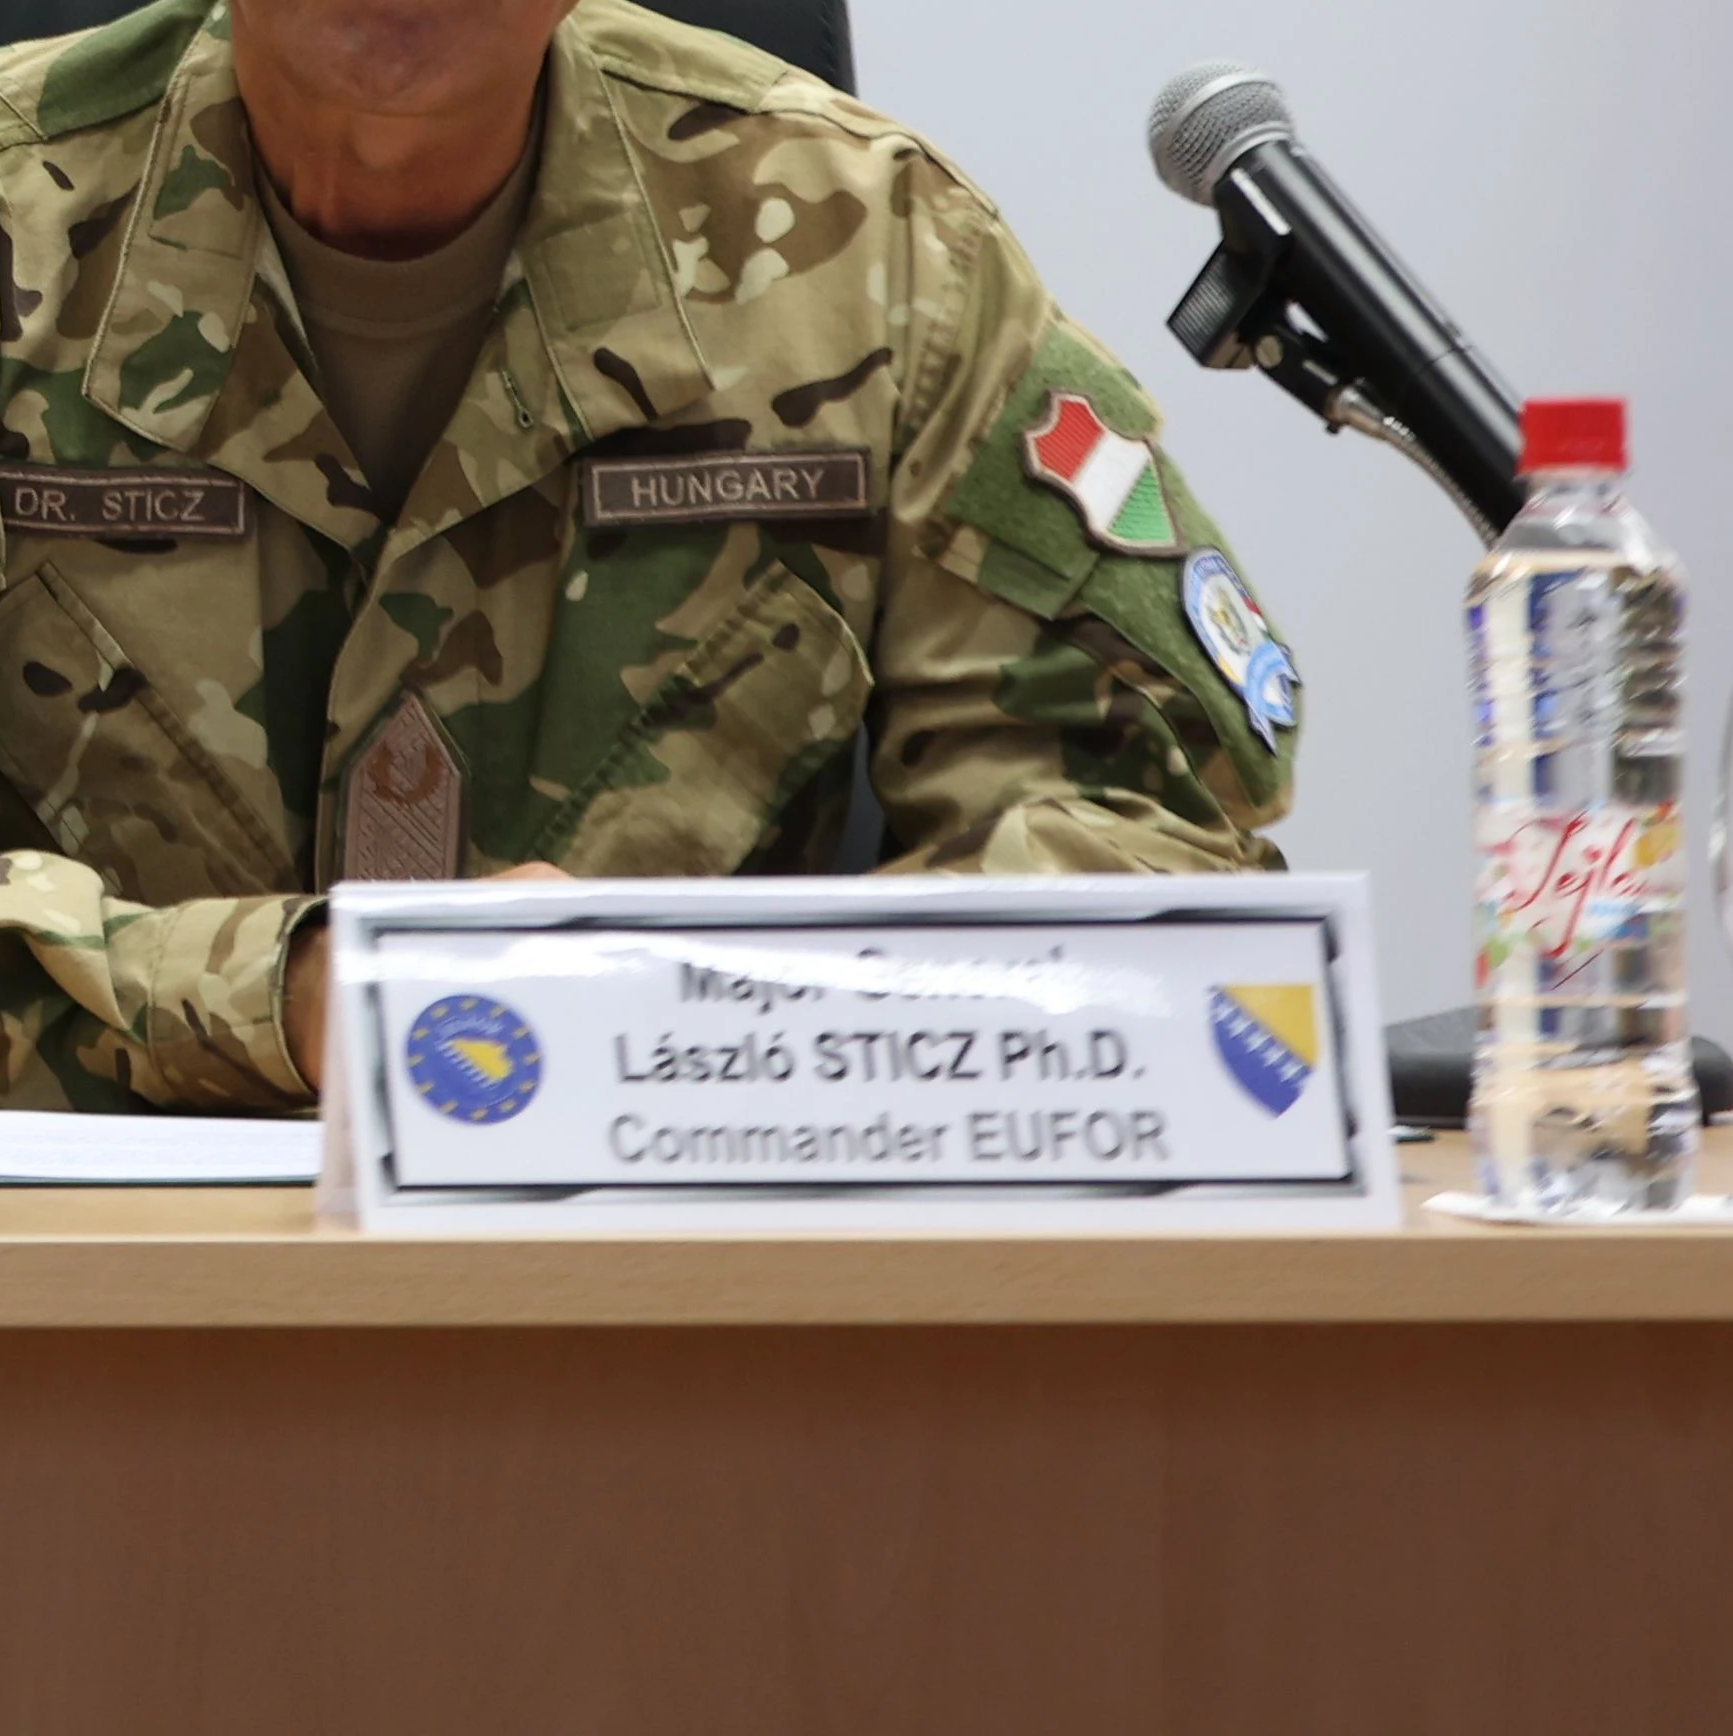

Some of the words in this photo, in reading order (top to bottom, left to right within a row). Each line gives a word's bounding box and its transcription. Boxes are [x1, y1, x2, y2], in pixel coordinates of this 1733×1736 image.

[14, 487, 76, 522] DR.
[101, 490, 207, 522] STICZ
[632, 467, 825, 508] HUNGARY
[613, 1030, 795, 1084] László
[813, 1029, 982, 1081] STICZ
[997, 1028, 1148, 1083] Ph.D.
[608, 1111, 949, 1166] Commander
[966, 1109, 1171, 1164] EUFOR
